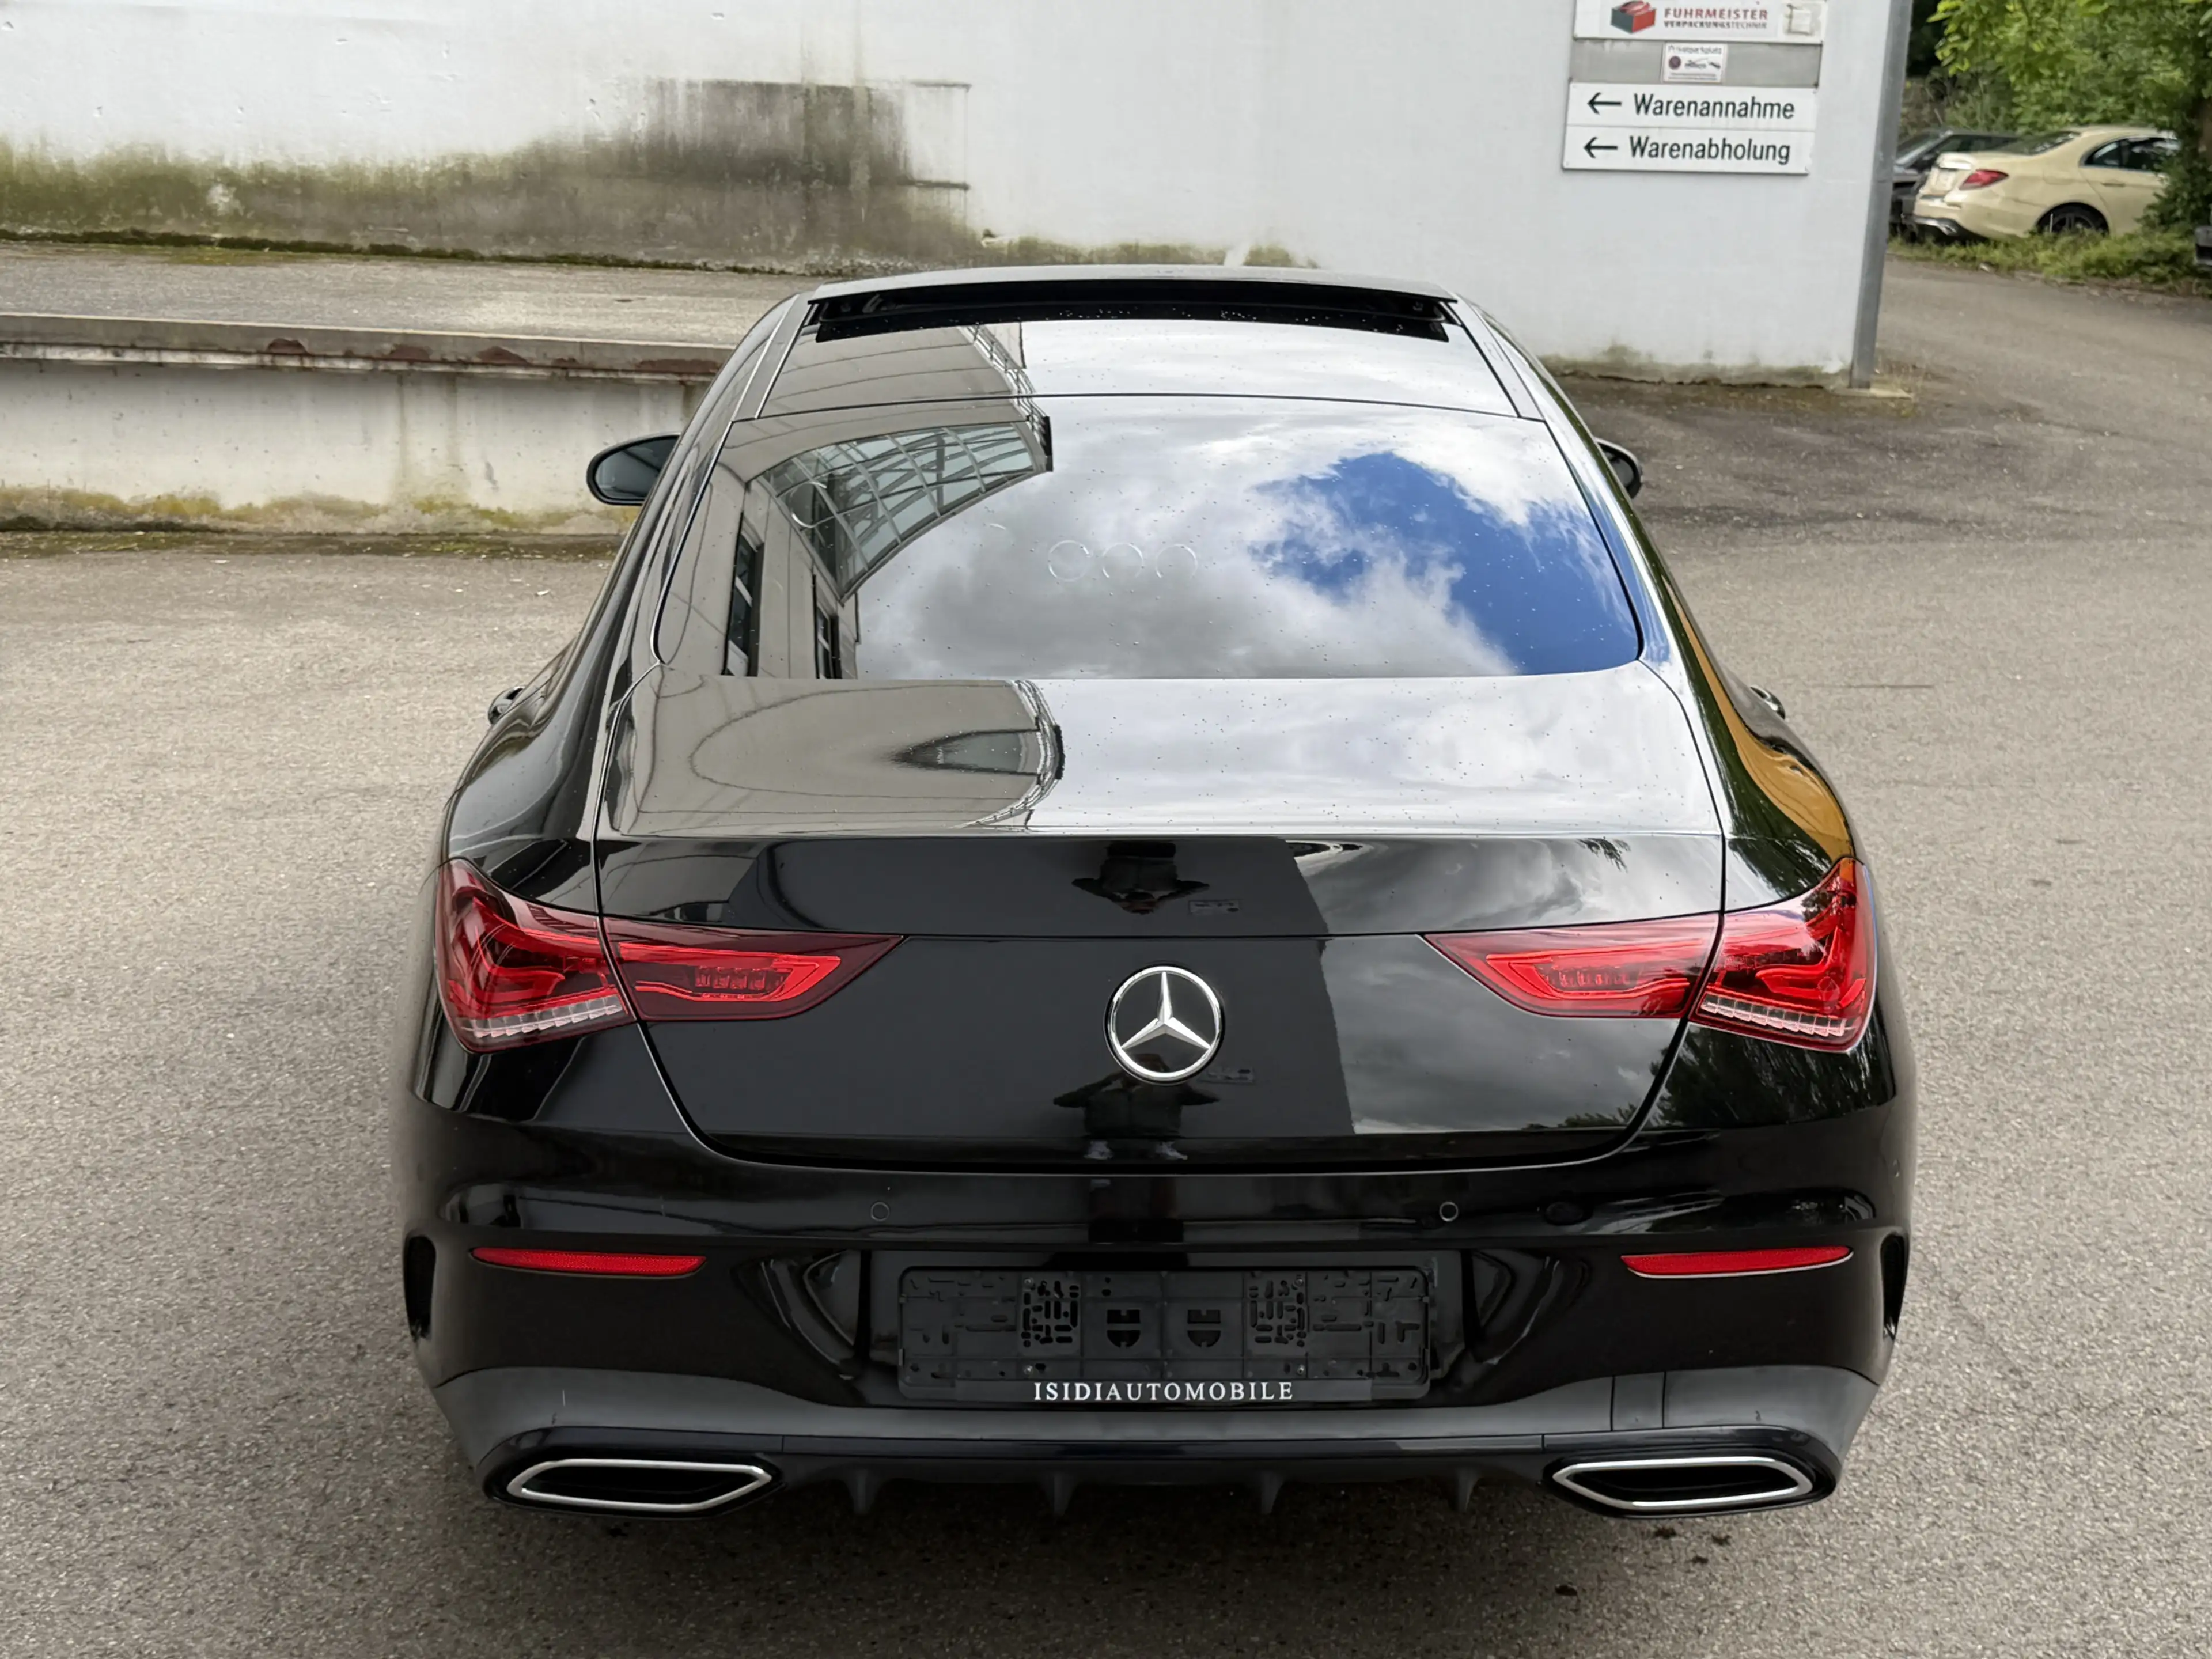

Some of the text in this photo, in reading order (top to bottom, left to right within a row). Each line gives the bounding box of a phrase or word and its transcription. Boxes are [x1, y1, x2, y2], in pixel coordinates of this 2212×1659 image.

[1664, 8, 1768, 20] FUHRMEISTER
[1664, 21, 1767, 29] VERPACKUNGSTECHNIK
[1634, 93, 1794, 119] Warenannahme
[1629, 135, 1790, 165] Warenabholung
[1034, 1382, 1293, 1401] ISIDIAUTOMOBILE
